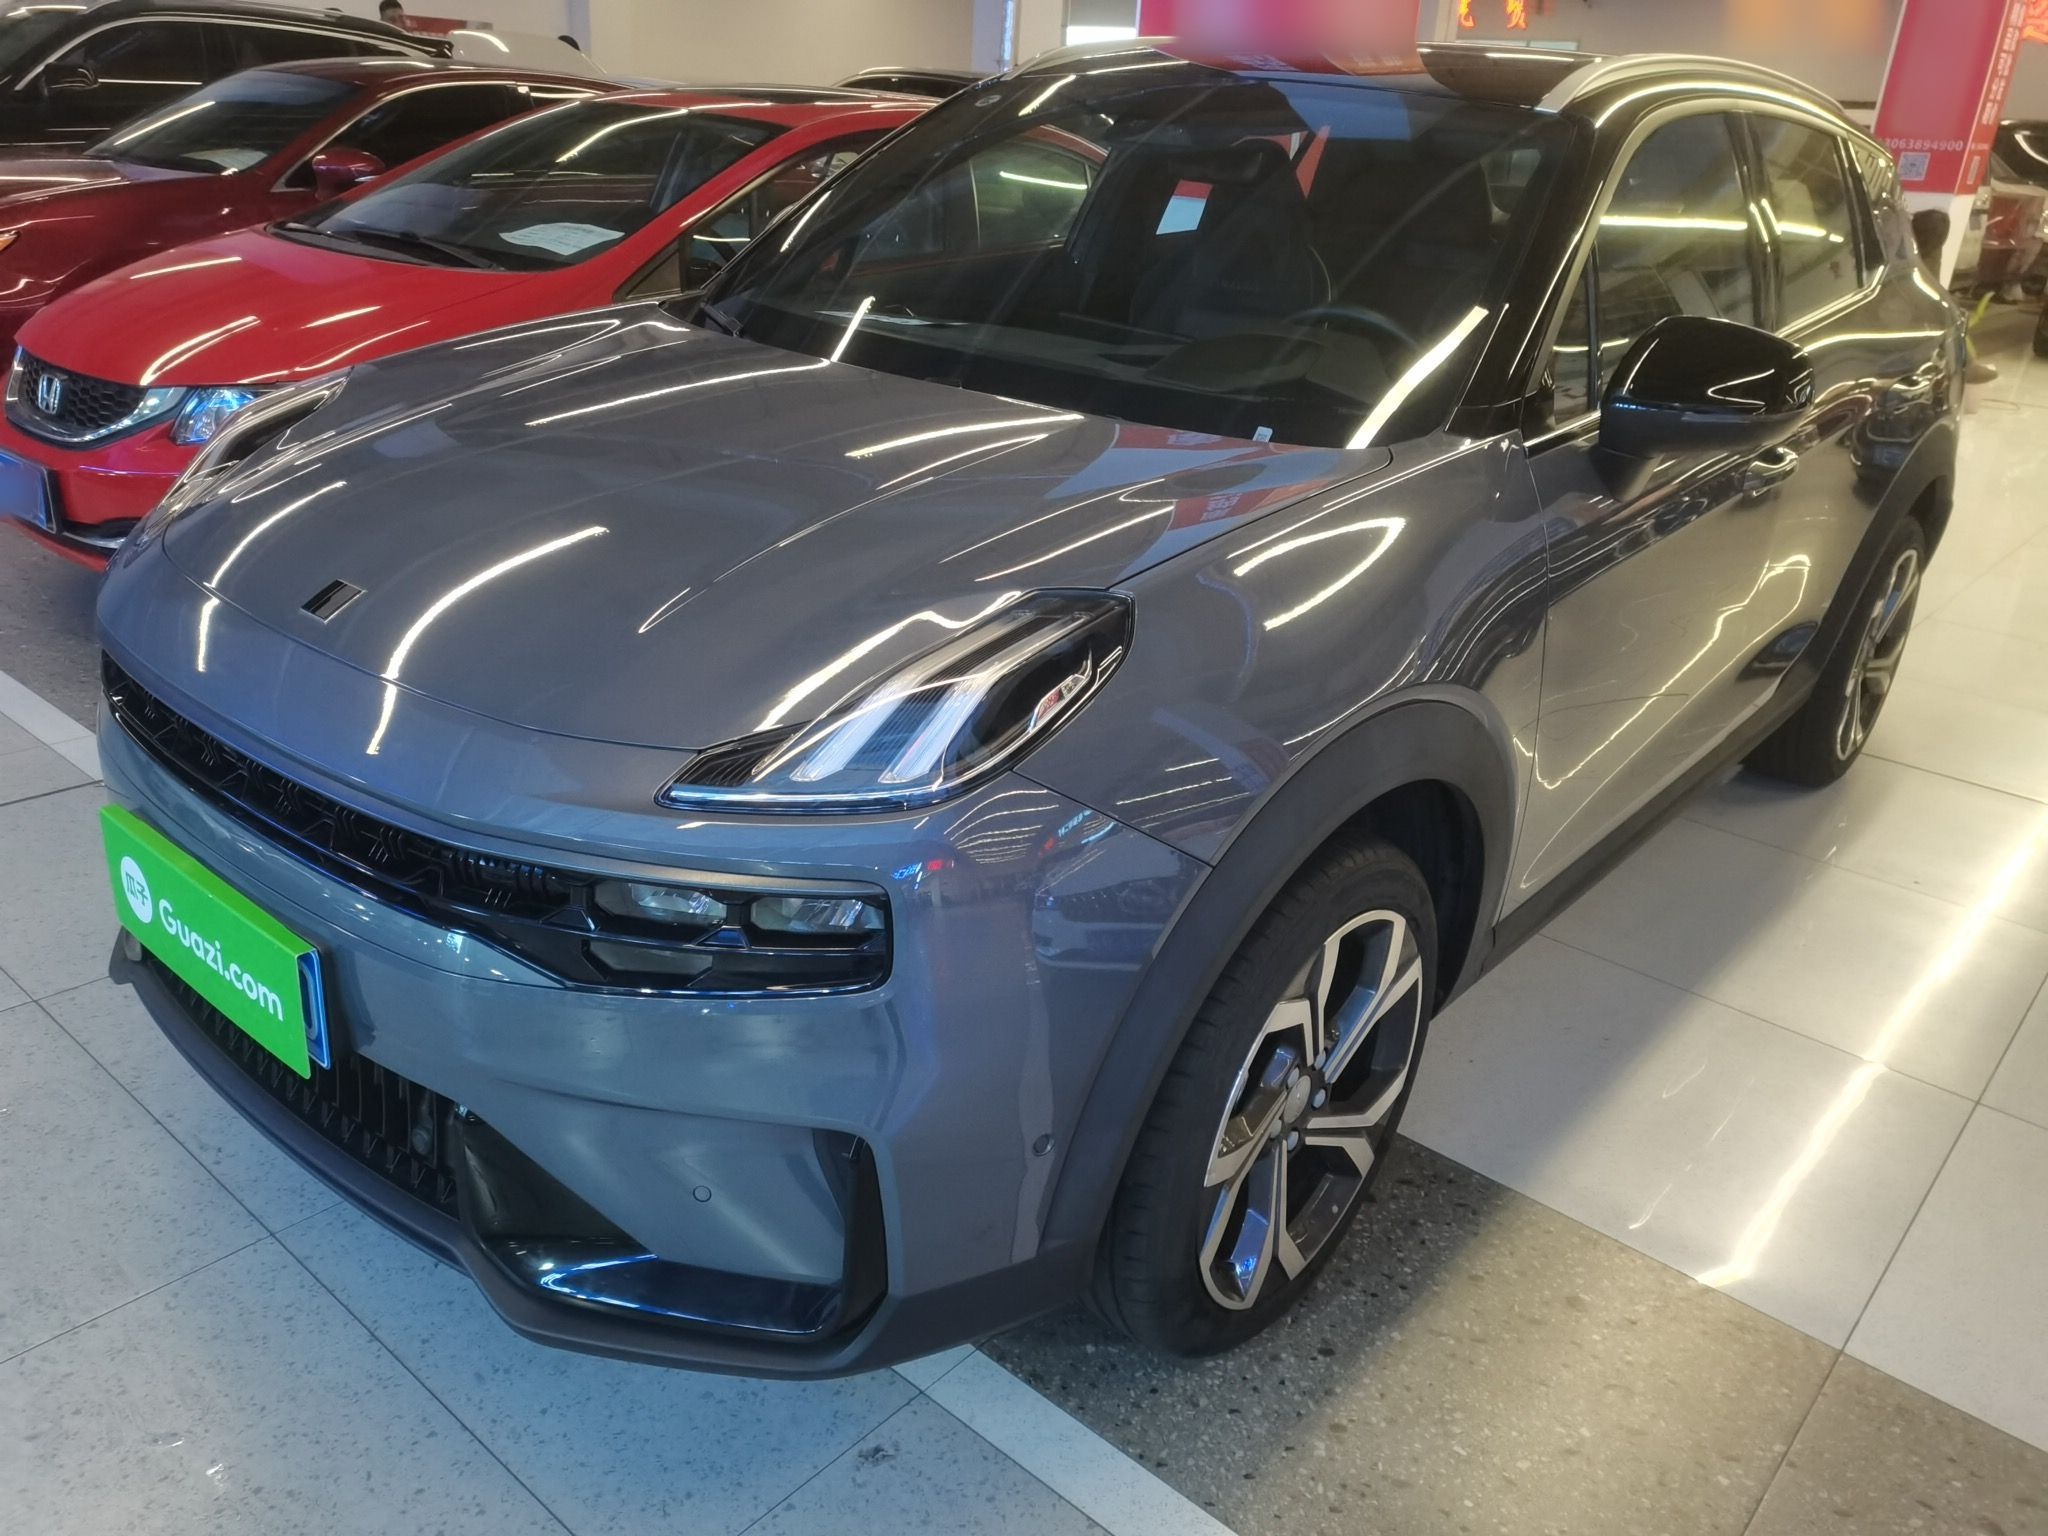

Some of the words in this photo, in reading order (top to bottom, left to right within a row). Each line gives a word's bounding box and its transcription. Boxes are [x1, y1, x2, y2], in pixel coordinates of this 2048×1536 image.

[1881, 138, 1964, 151] 3063894900
[125, 871, 149, 906] 瓜子
[159, 899, 283, 1021] Guazi.com
